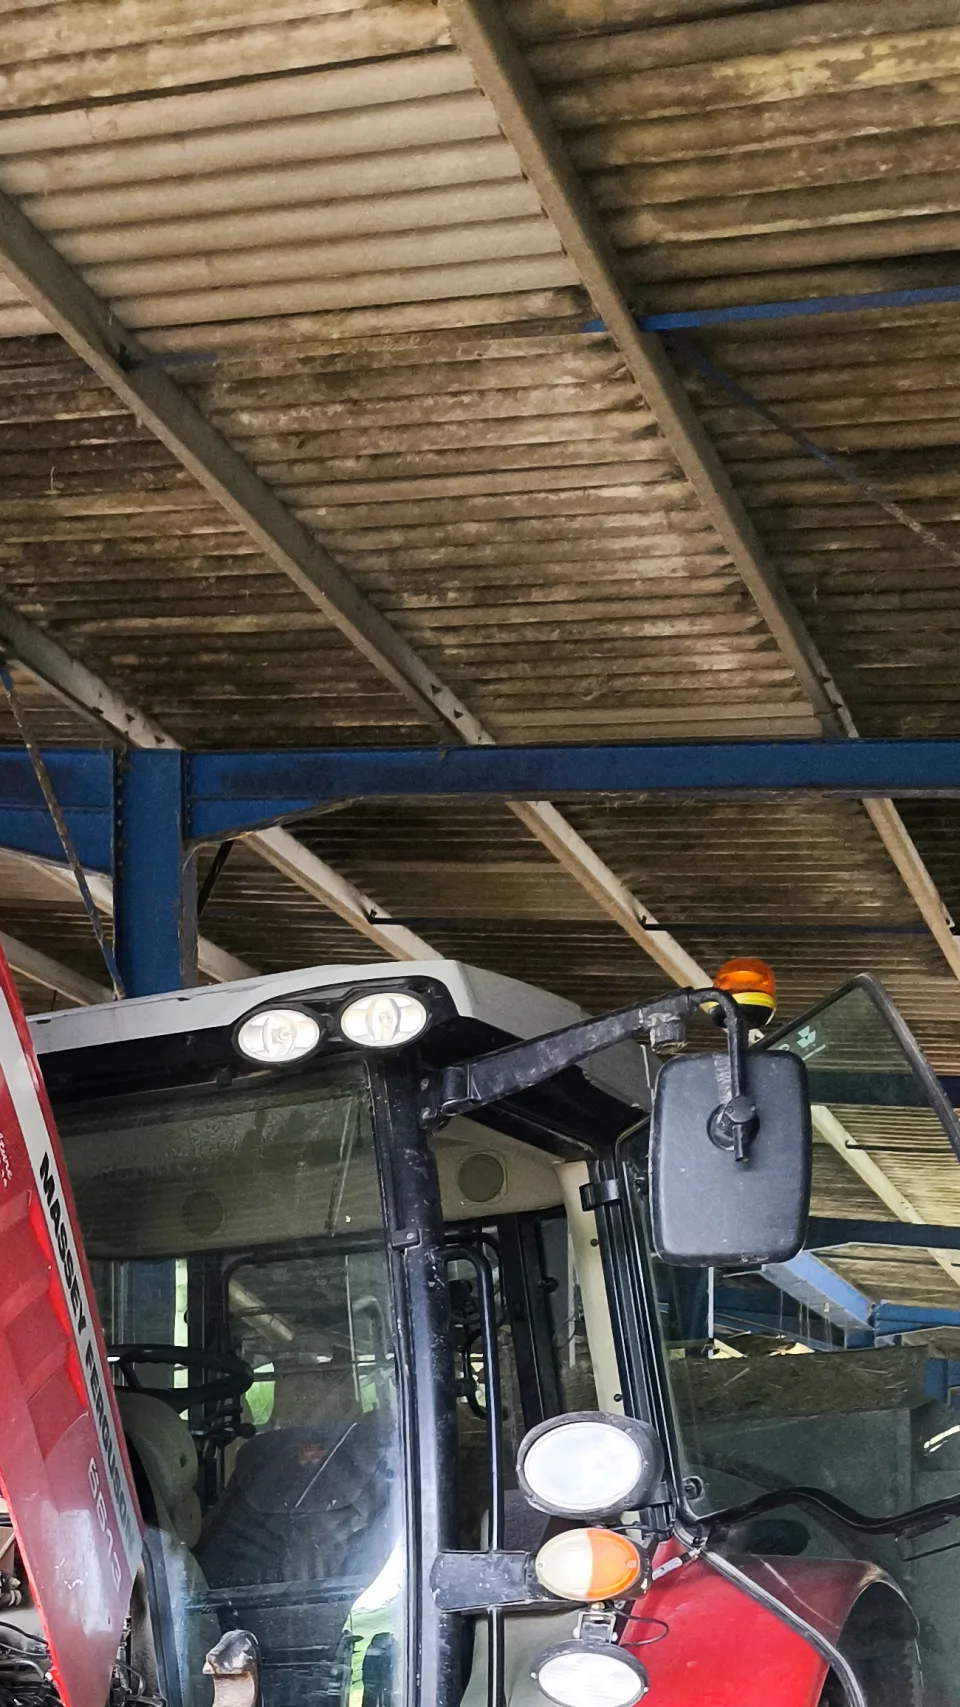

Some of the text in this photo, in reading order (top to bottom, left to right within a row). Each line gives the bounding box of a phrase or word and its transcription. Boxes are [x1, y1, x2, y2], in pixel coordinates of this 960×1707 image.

[40, 1151, 137, 1547] MASSEY FERGUSON
[88, 1456, 123, 1593] 6613
